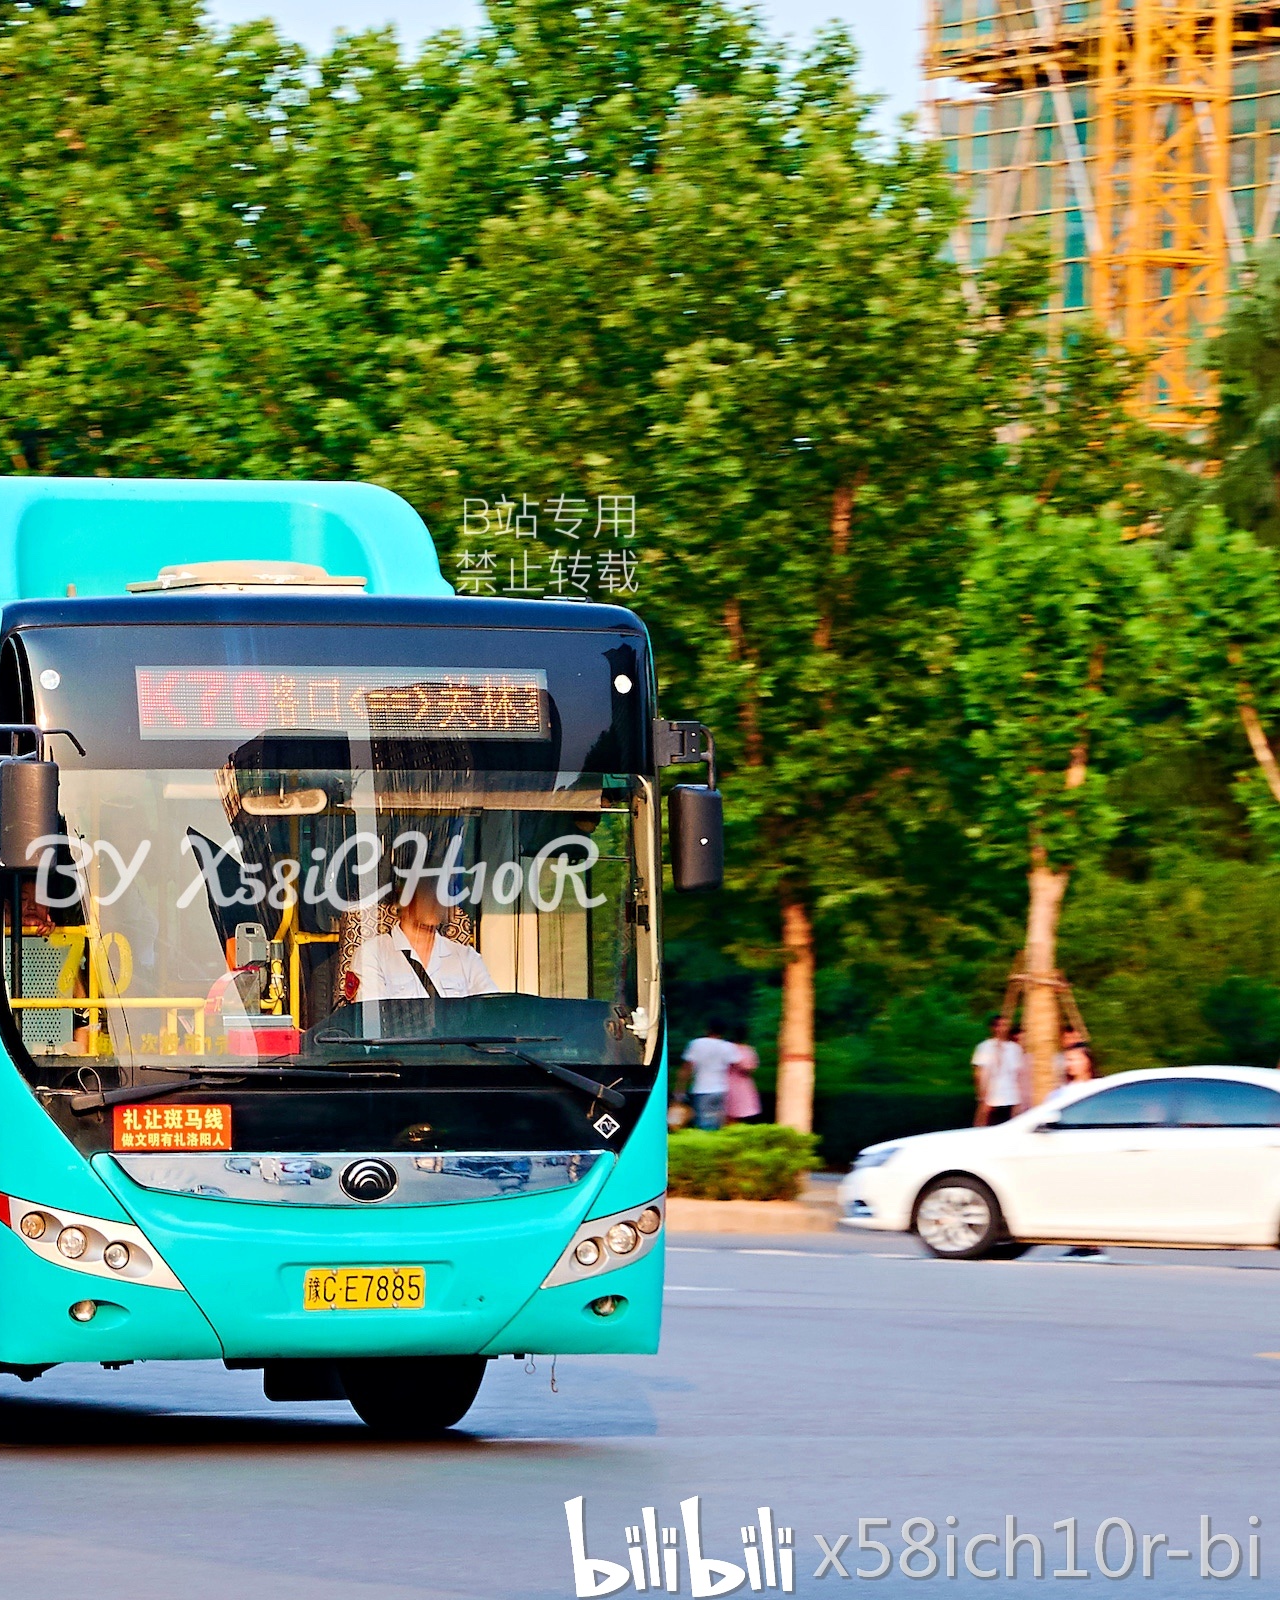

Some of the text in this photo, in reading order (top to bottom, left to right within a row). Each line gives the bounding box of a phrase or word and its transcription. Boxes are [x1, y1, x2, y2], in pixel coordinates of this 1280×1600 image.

[139, 670, 269, 728] K70
[48, 931, 133, 996] 70
[122, 1108, 224, 1131] 礼让斑马线
[121, 1132, 225, 1148] 做文明有礼洛阳人
